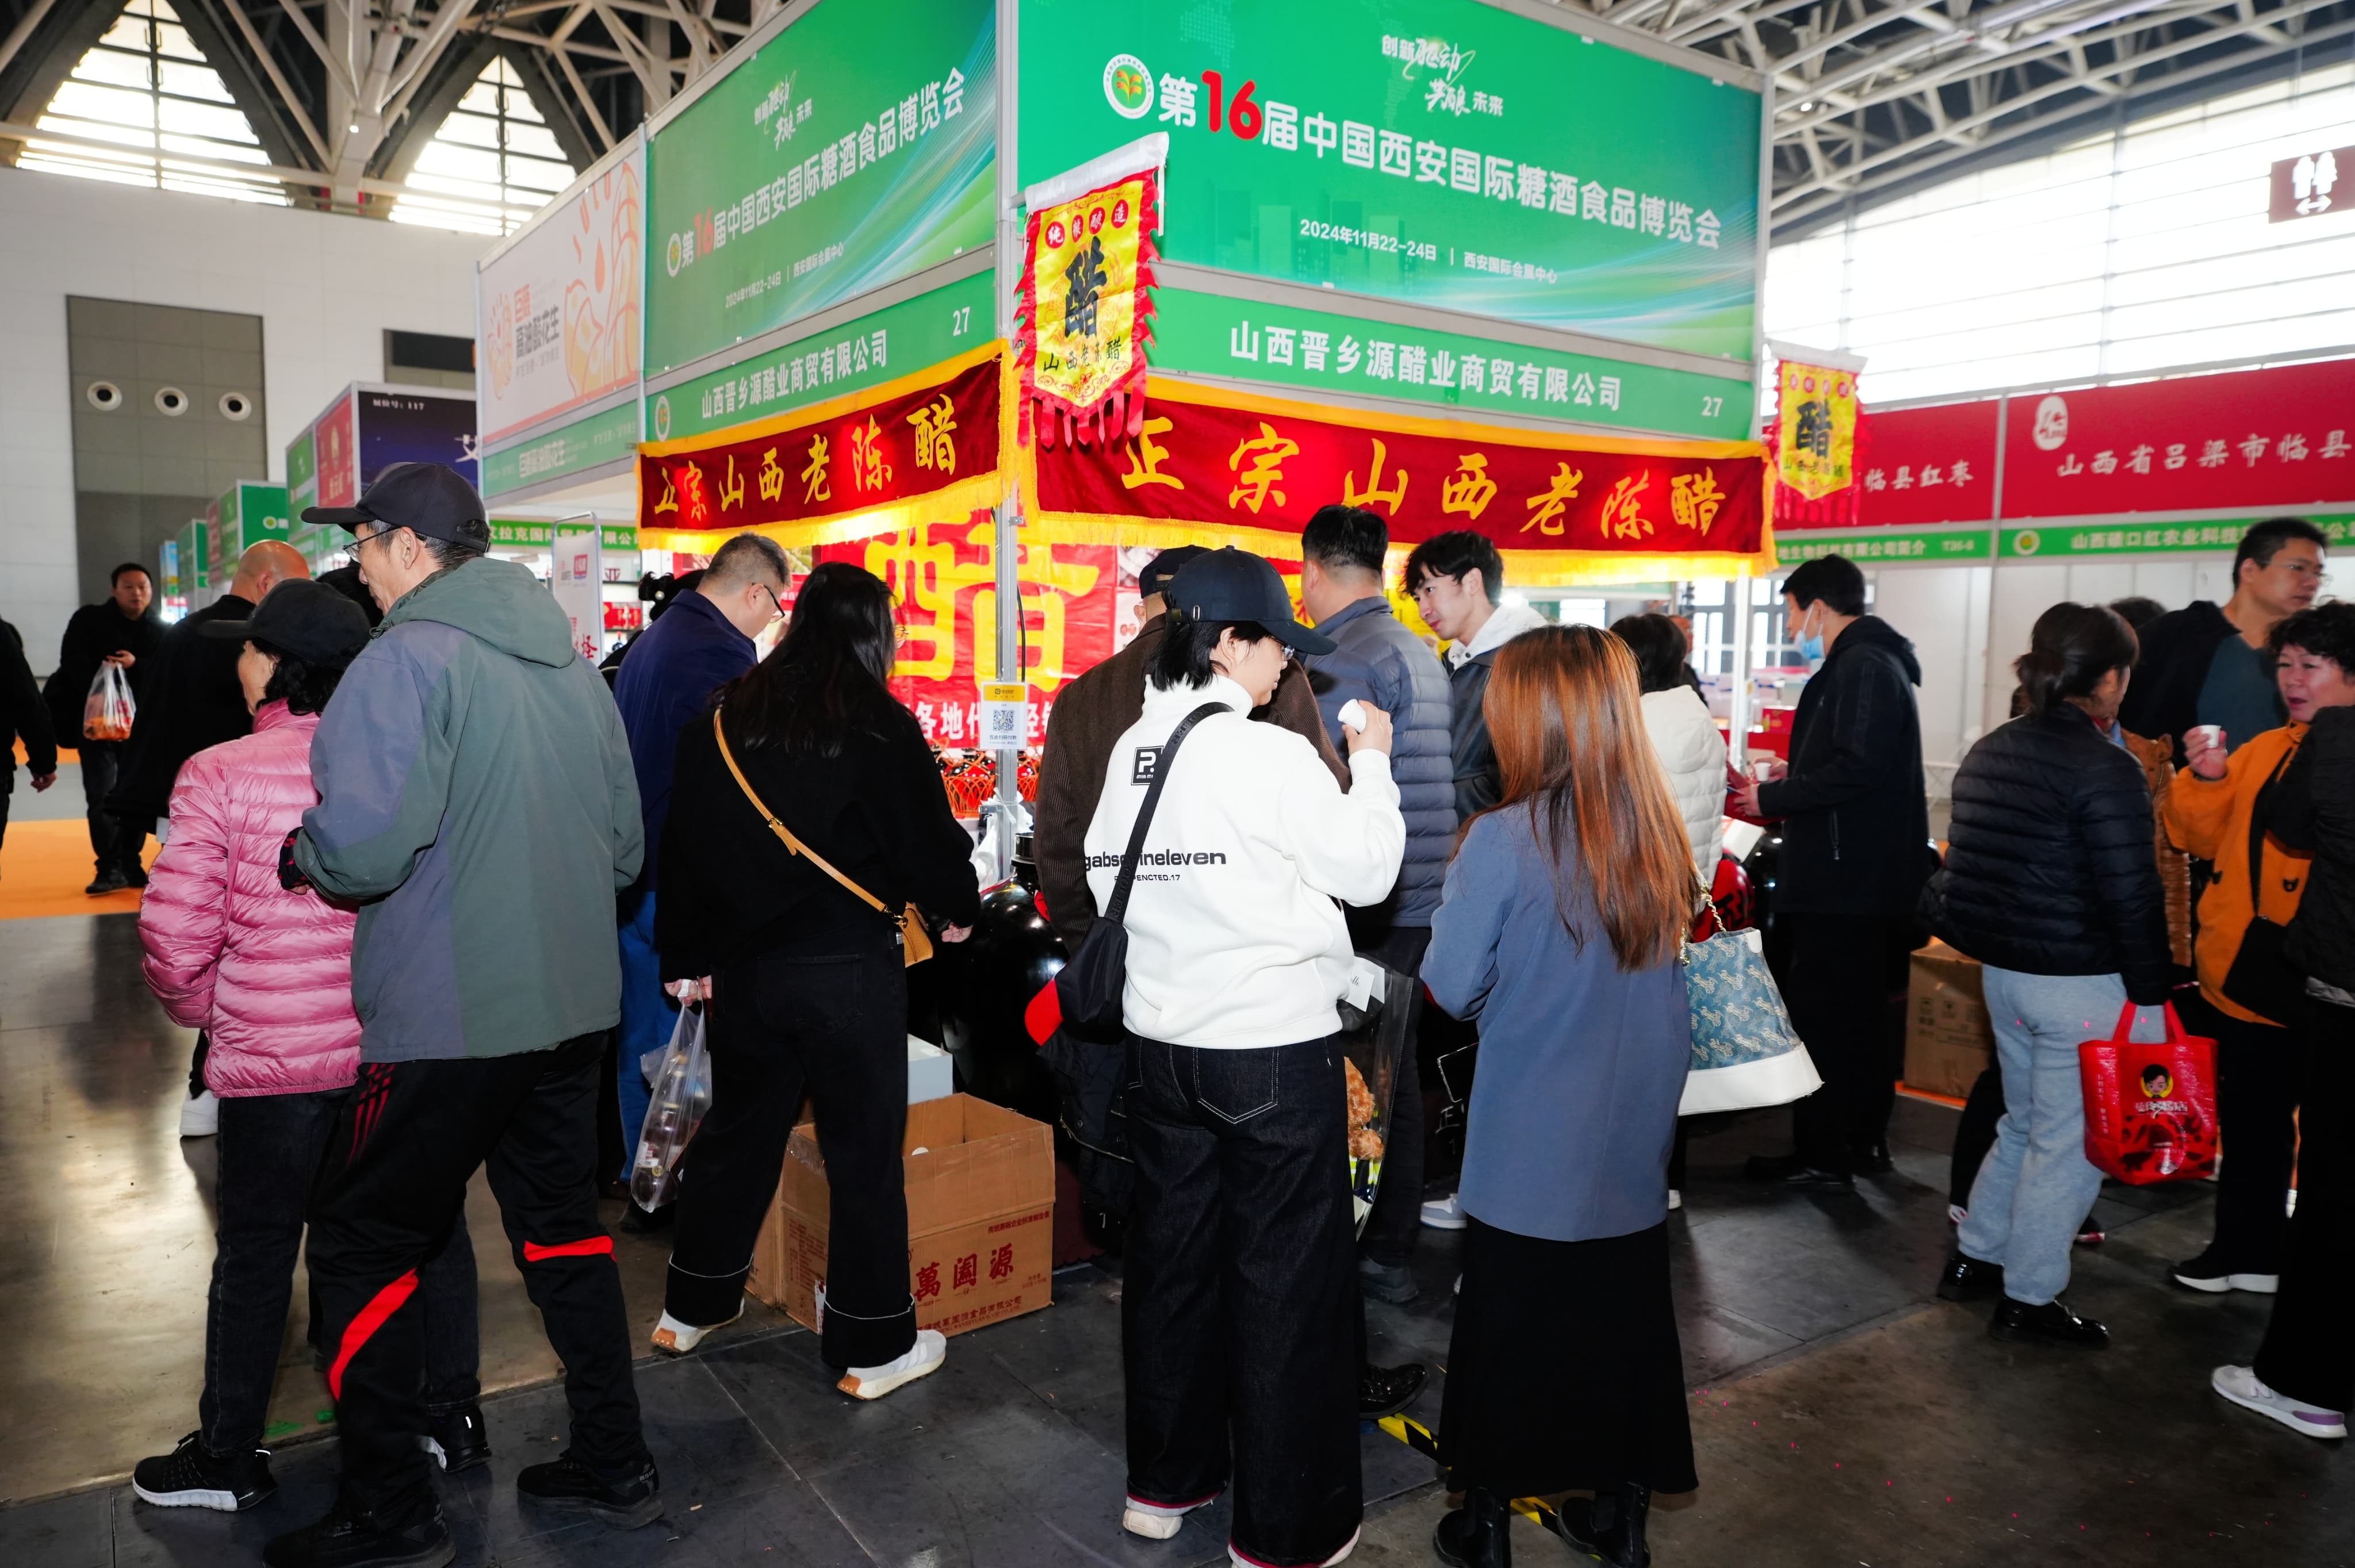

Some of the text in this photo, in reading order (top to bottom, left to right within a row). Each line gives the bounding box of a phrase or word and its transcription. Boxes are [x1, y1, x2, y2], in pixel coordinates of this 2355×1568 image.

[681, 67, 967, 270] 第16届中国西安国际糖酒食品博览会
[1158, 70, 1721, 250] 第16届中国西安国际糖酒食品博览会
[1064, 236, 1108, 339] 醋
[1300, 219, 1558, 284] 2024年11月22-24日 西安国际会展中心
[702, 306, 971, 420] 山西晋乡源醋业商贸有限公司 27
[1231, 320, 1723, 418] 山西晋乡源醋业商贸有限公司 27
[1121, 416, 1725, 540] 正宗山西老陈醋
[1864, 459, 1974, 493] 临县红枣
[2057, 430, 2352, 477] 山西省吕梁市临县
